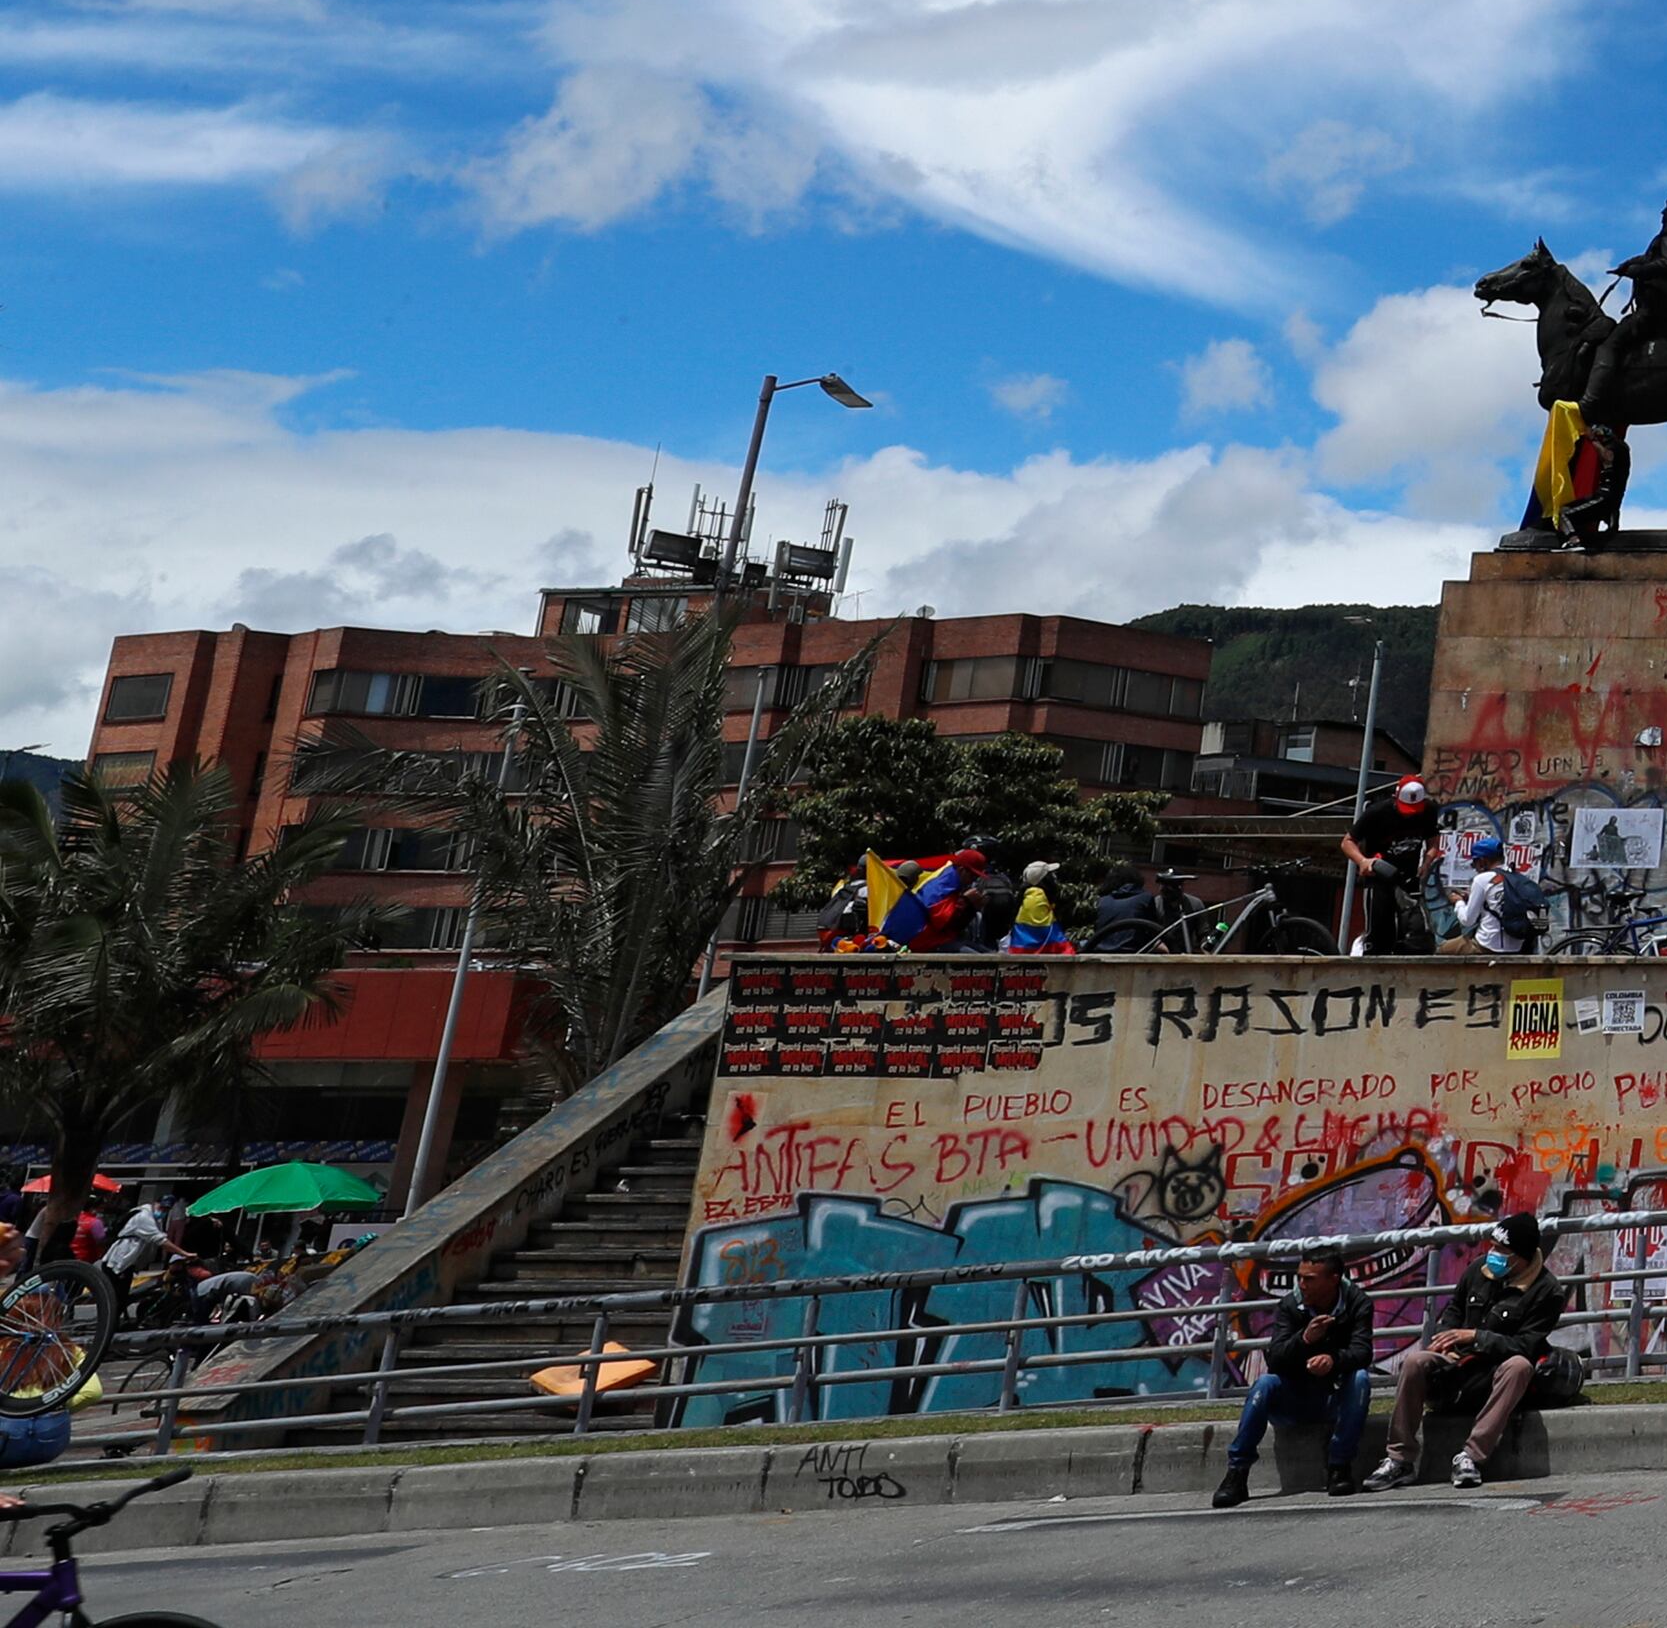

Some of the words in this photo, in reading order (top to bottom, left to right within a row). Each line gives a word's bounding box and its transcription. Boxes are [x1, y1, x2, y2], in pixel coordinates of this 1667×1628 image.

[1435, 748, 1521, 774] ESTADO
[1605, 992, 1644, 1000] COLOMBIA
[1512, 1002, 1560, 1034] DIGNA
[1509, 1031, 1560, 1051] RABIA
[886, 1101, 927, 1129] EL
[963, 1088, 1072, 1124] PUEBLO
[1120, 1087, 1148, 1113] ES
[1203, 1074, 1397, 1112] DESANGRADO
[1430, 1070, 1479, 1099] POR
[1511, 1072, 1597, 1108] PROPIO
[710, 1121, 916, 1195] ANTIFAS
[931, 1128, 1033, 1183] BTA
[1086, 1113, 1246, 1169] UNIDAD
[799, 1441, 869, 1474] ANTI
